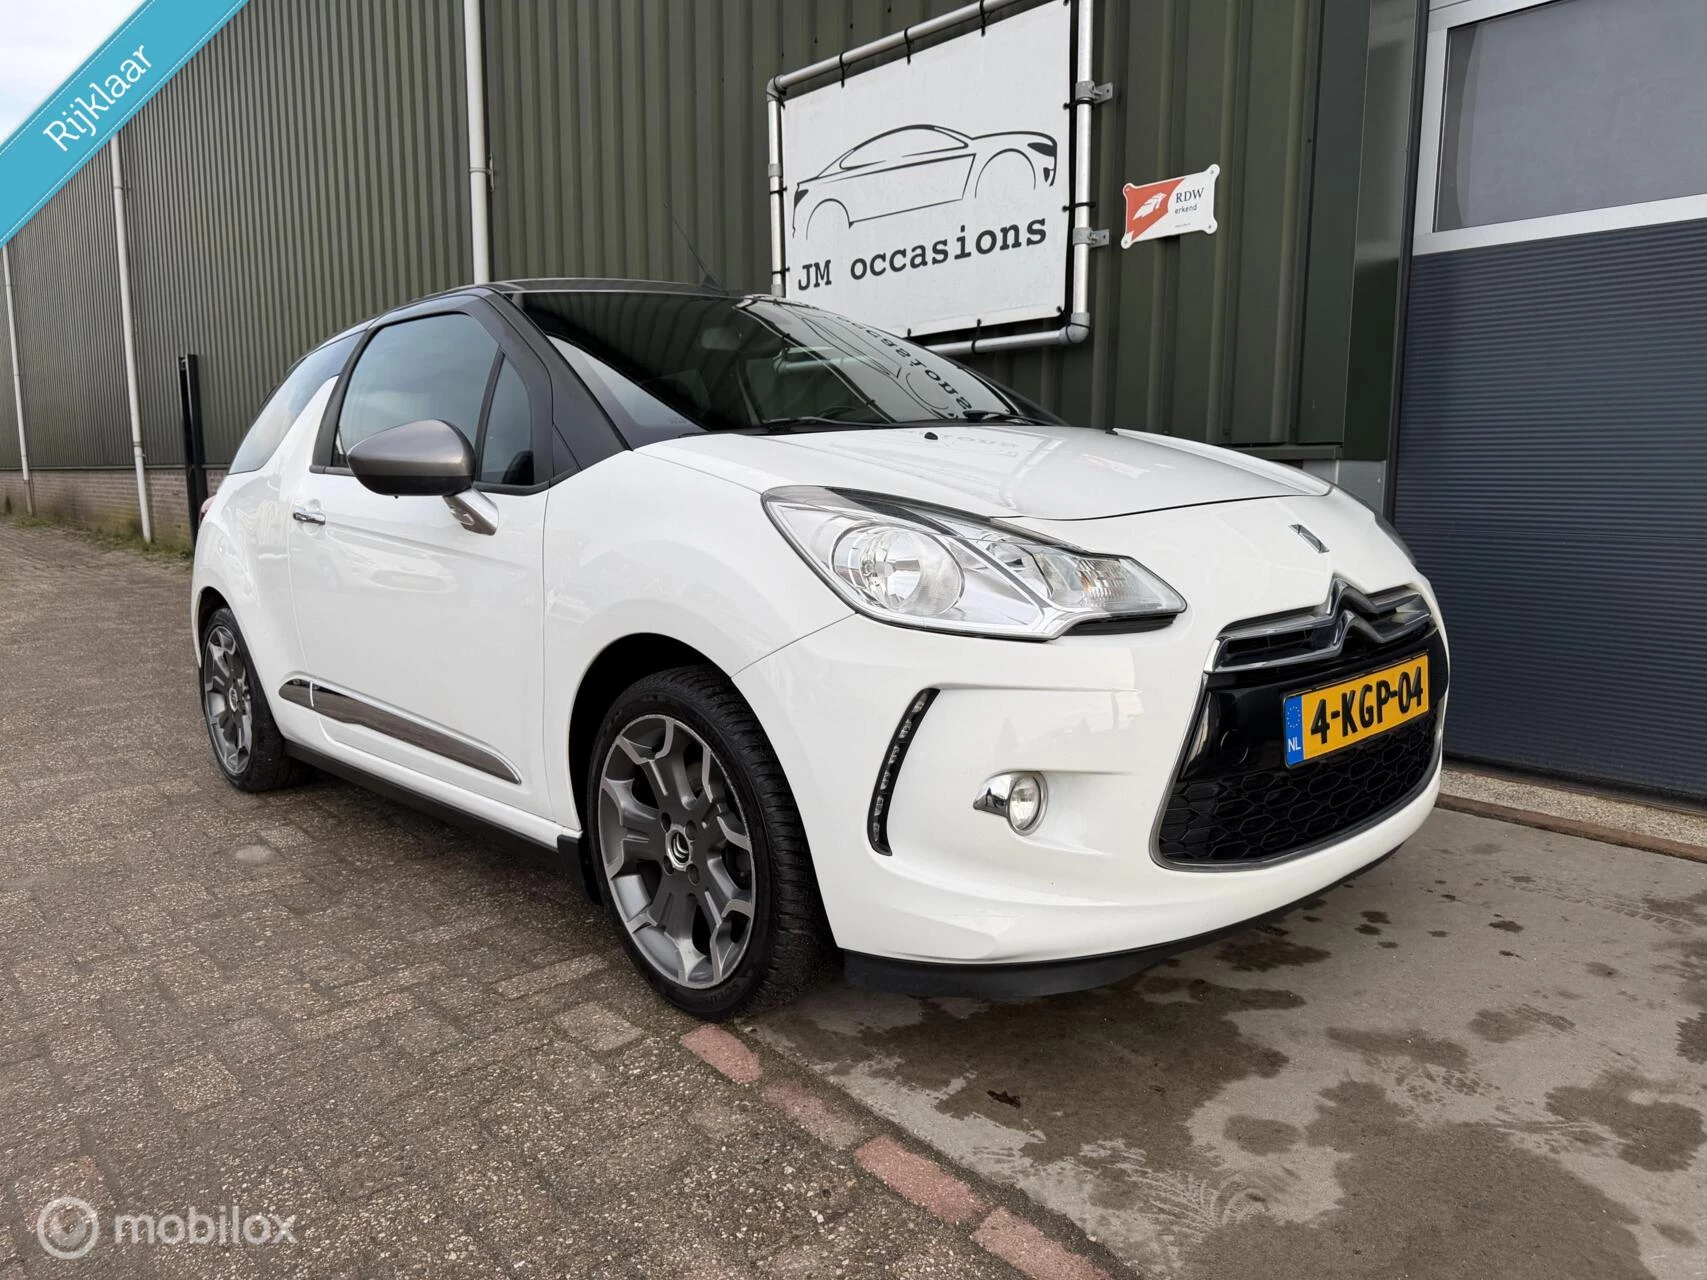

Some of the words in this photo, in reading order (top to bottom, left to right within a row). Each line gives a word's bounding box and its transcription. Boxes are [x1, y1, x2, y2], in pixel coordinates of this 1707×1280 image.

[1175, 187, 1204, 204] RDW
[1174, 203, 1198, 215] erkend
[798, 259, 832, 291] JM
[850, 218, 1047, 281] occasions
[1310, 666, 1423, 745] 4-KGP-04
[1287, 736, 1301, 753] NL
